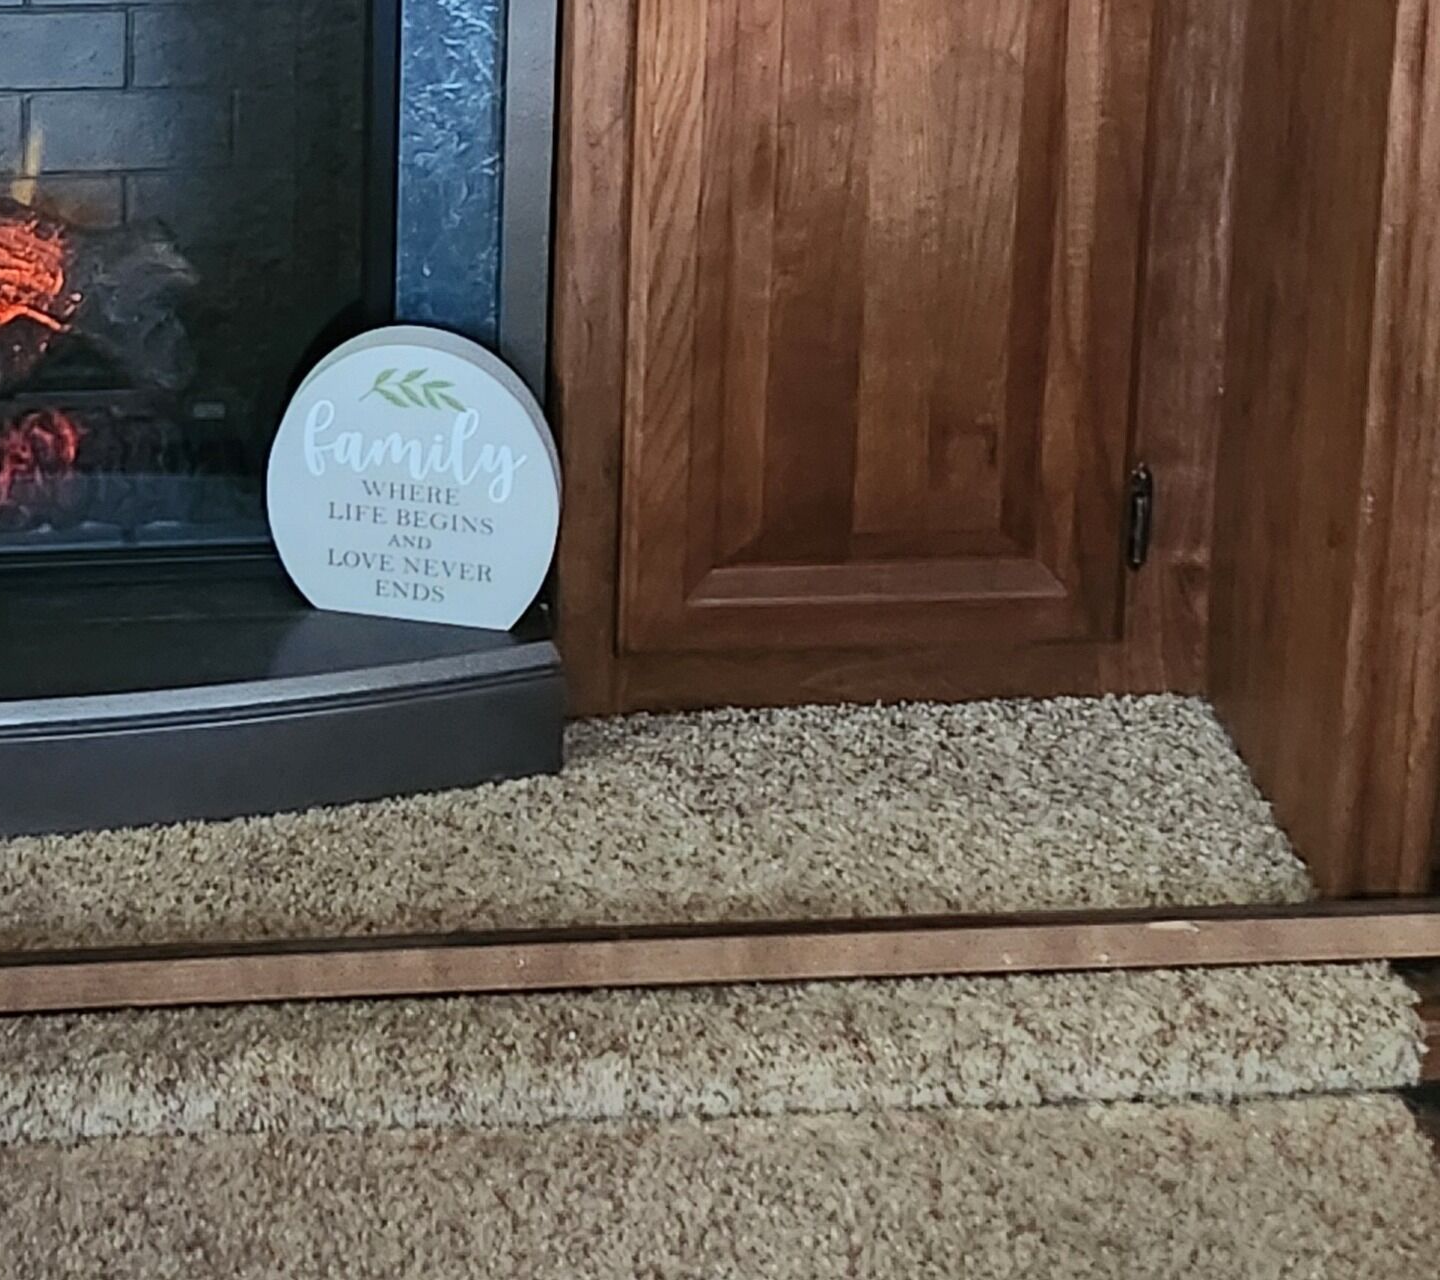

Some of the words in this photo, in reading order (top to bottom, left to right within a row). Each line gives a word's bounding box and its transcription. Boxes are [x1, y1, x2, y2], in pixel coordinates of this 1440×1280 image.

[304, 400, 528, 503] family
[362, 479, 460, 507] WHERE
[328, 501, 388, 525] LIFE
[397, 507, 494, 536] BEGINS
[388, 533, 432, 550] AND
[328, 548, 396, 573] LOVE
[403, 556, 493, 584] NEVER
[375, 578, 446, 604] ENDS
